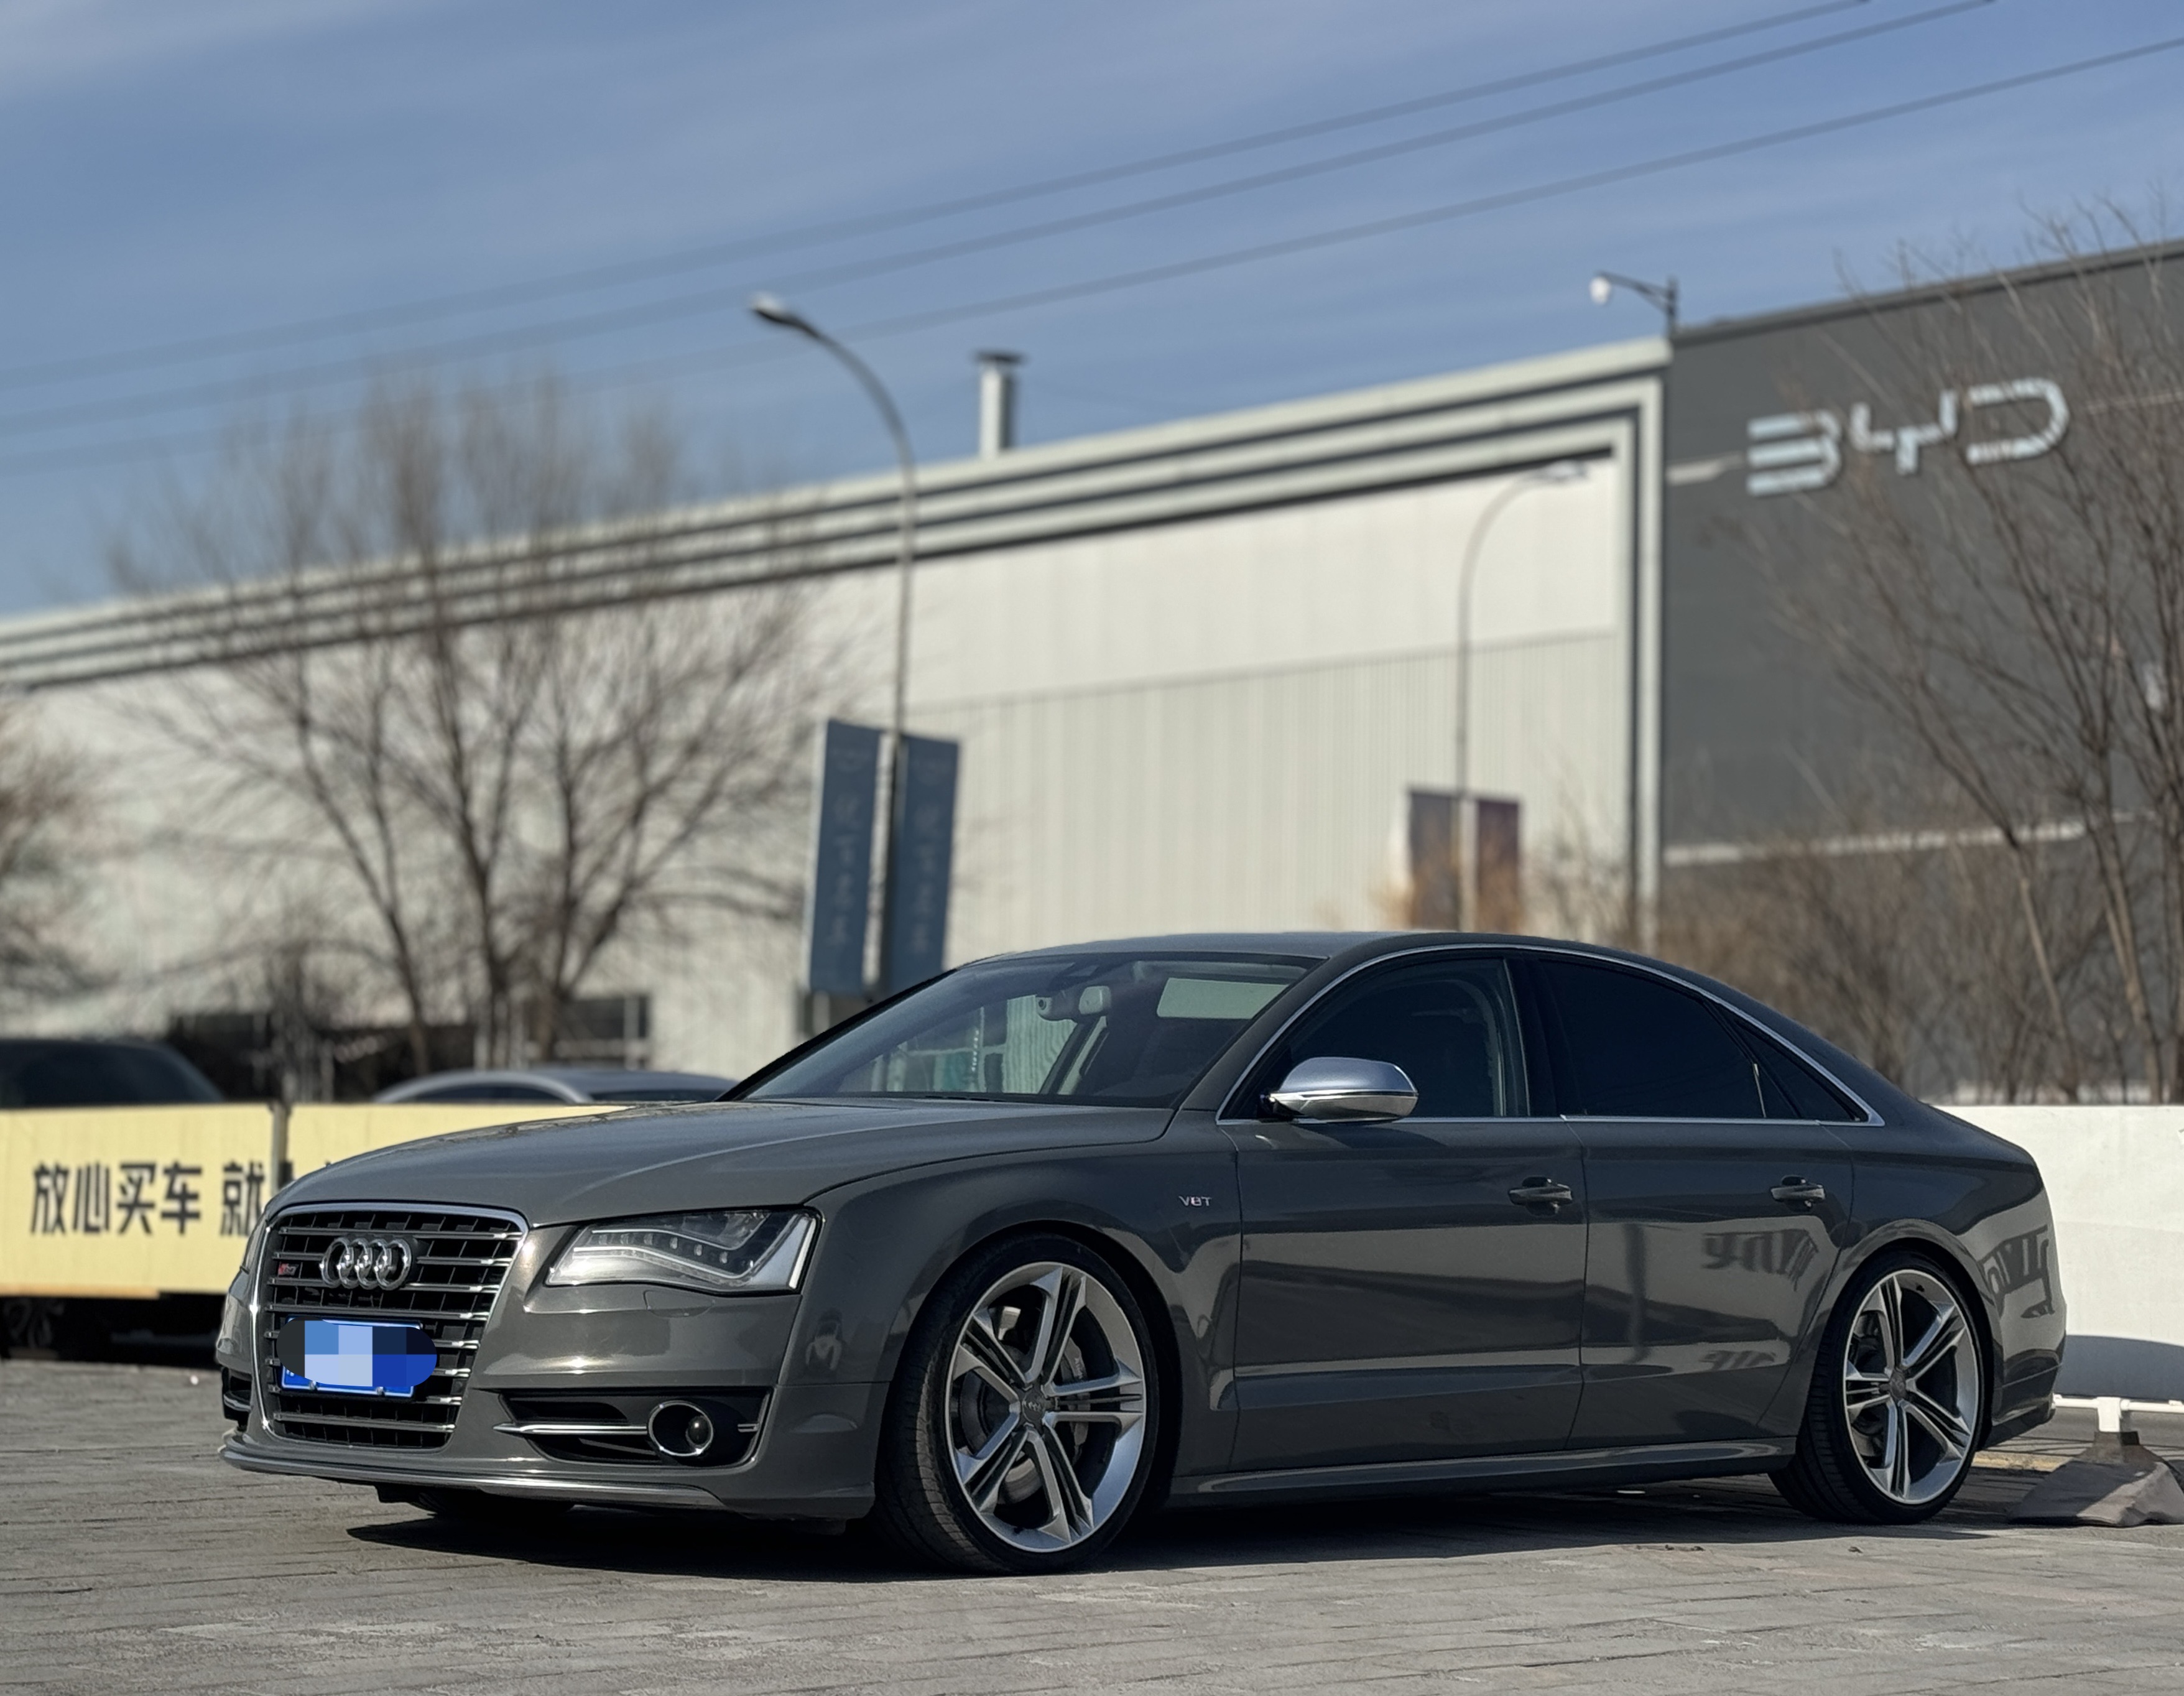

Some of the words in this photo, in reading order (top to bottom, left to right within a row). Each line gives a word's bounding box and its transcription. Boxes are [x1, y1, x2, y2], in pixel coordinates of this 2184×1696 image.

[1747, 377, 2070, 496] BYD
[31, 1161, 203, 1236] 放心买车
